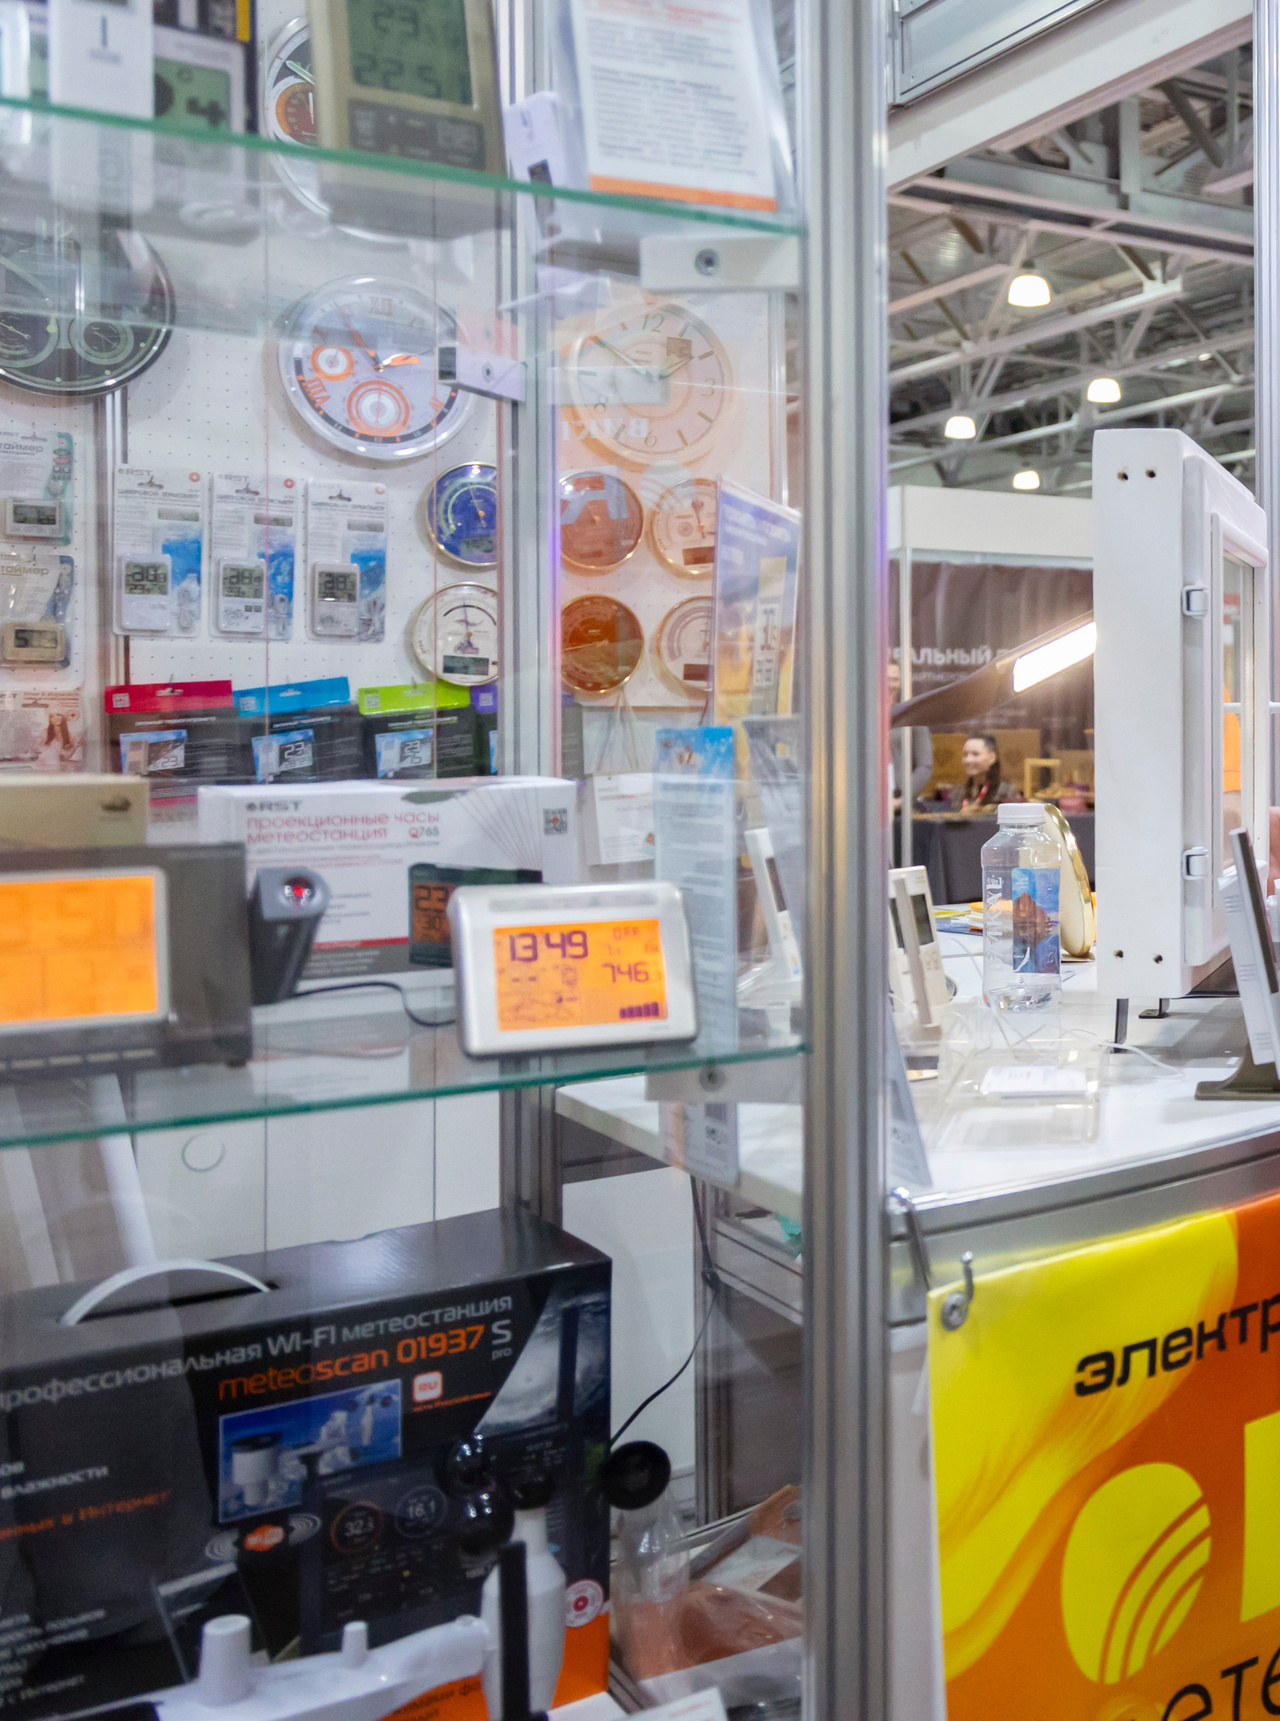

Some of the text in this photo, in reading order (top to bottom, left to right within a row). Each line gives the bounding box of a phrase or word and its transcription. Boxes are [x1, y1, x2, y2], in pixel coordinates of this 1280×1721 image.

[259, 801, 301, 811] RST
[247, 812, 440, 830] проекционные часы
[247, 827, 388, 844] метеостанция
[601, 961, 651, 984] 746
[342, 1296, 513, 1342] метеостанция
[219, 1318, 513, 1401] meteoscan 01937 S
